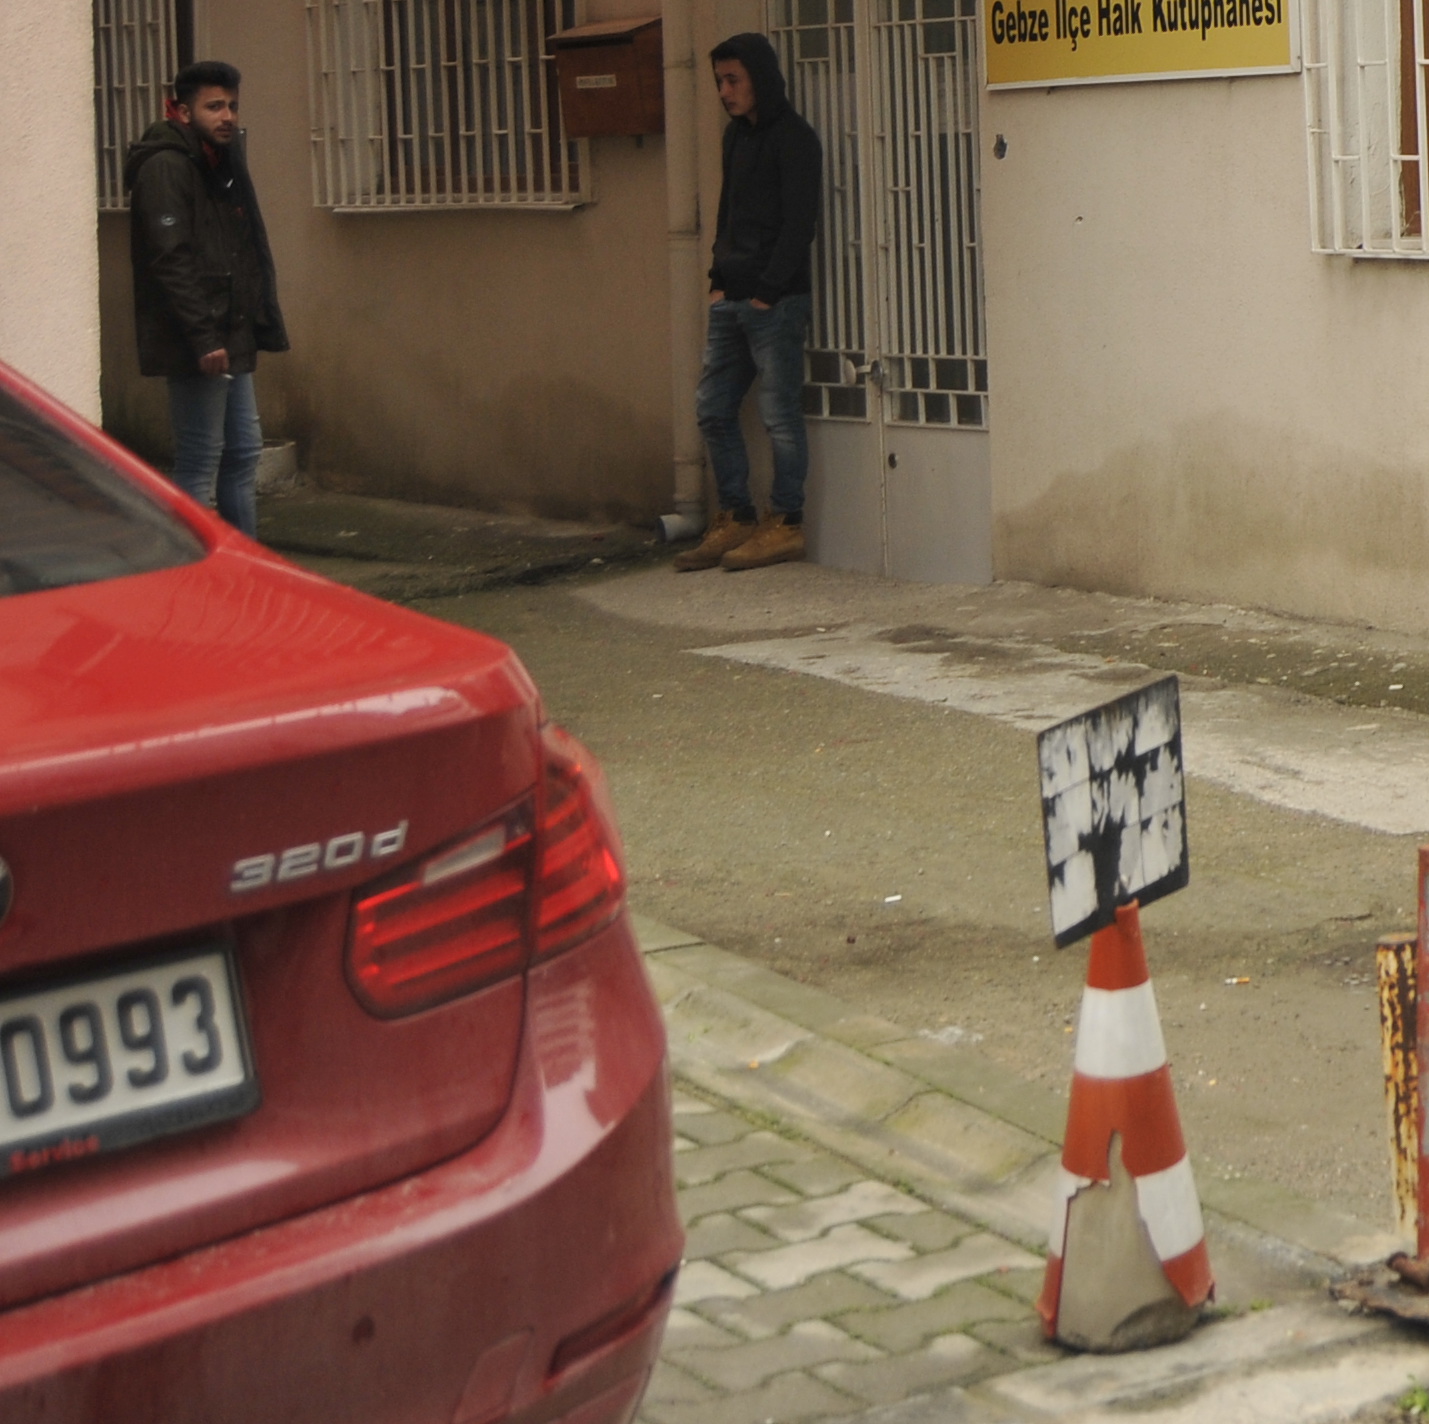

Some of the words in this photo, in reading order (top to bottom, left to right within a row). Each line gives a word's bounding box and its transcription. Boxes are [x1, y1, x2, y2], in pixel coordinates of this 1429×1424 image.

[991, 0, 1049, 44] Gebze
[229, 819, 409, 892] 320d
[0, 974, 223, 1119] 0993
